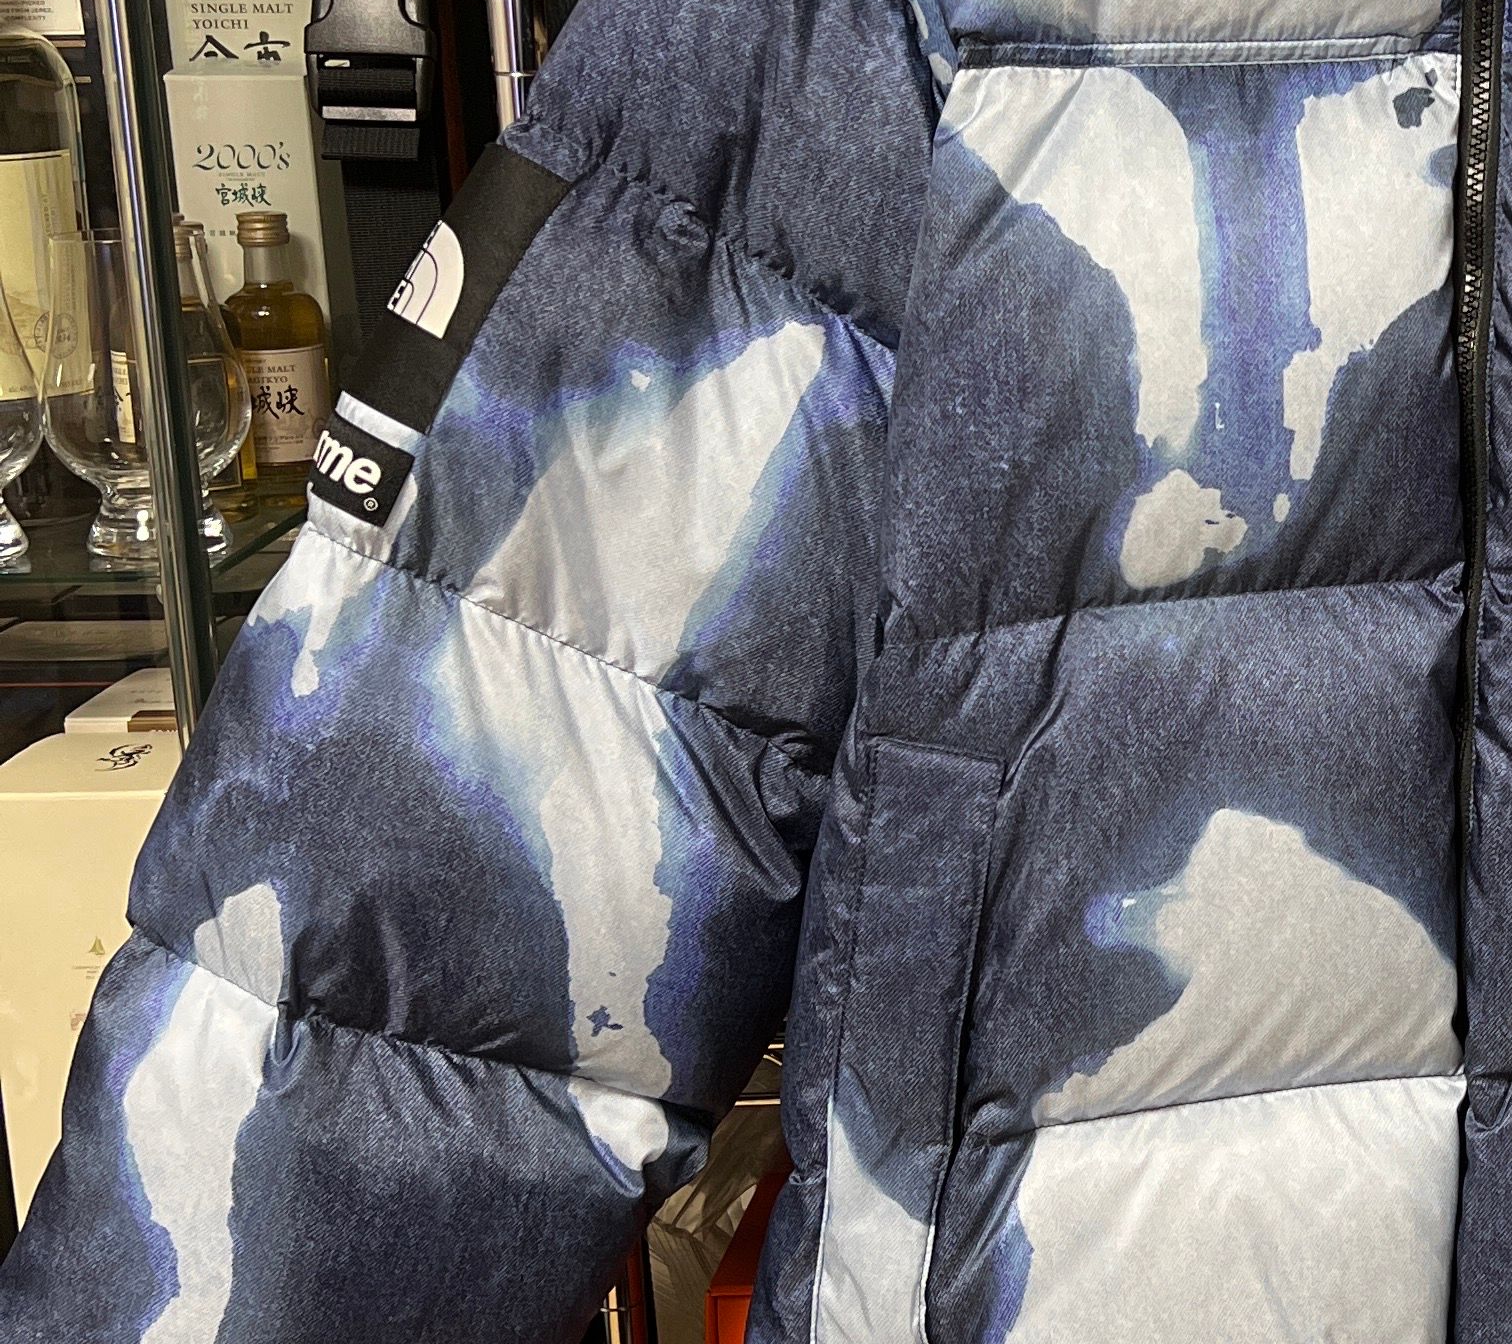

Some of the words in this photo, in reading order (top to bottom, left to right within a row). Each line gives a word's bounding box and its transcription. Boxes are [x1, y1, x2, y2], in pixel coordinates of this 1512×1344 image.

[190, 3, 249, 15] SINGLE
[252, 3, 294, 15] MALT
[192, 19, 250, 31] YOICHI
